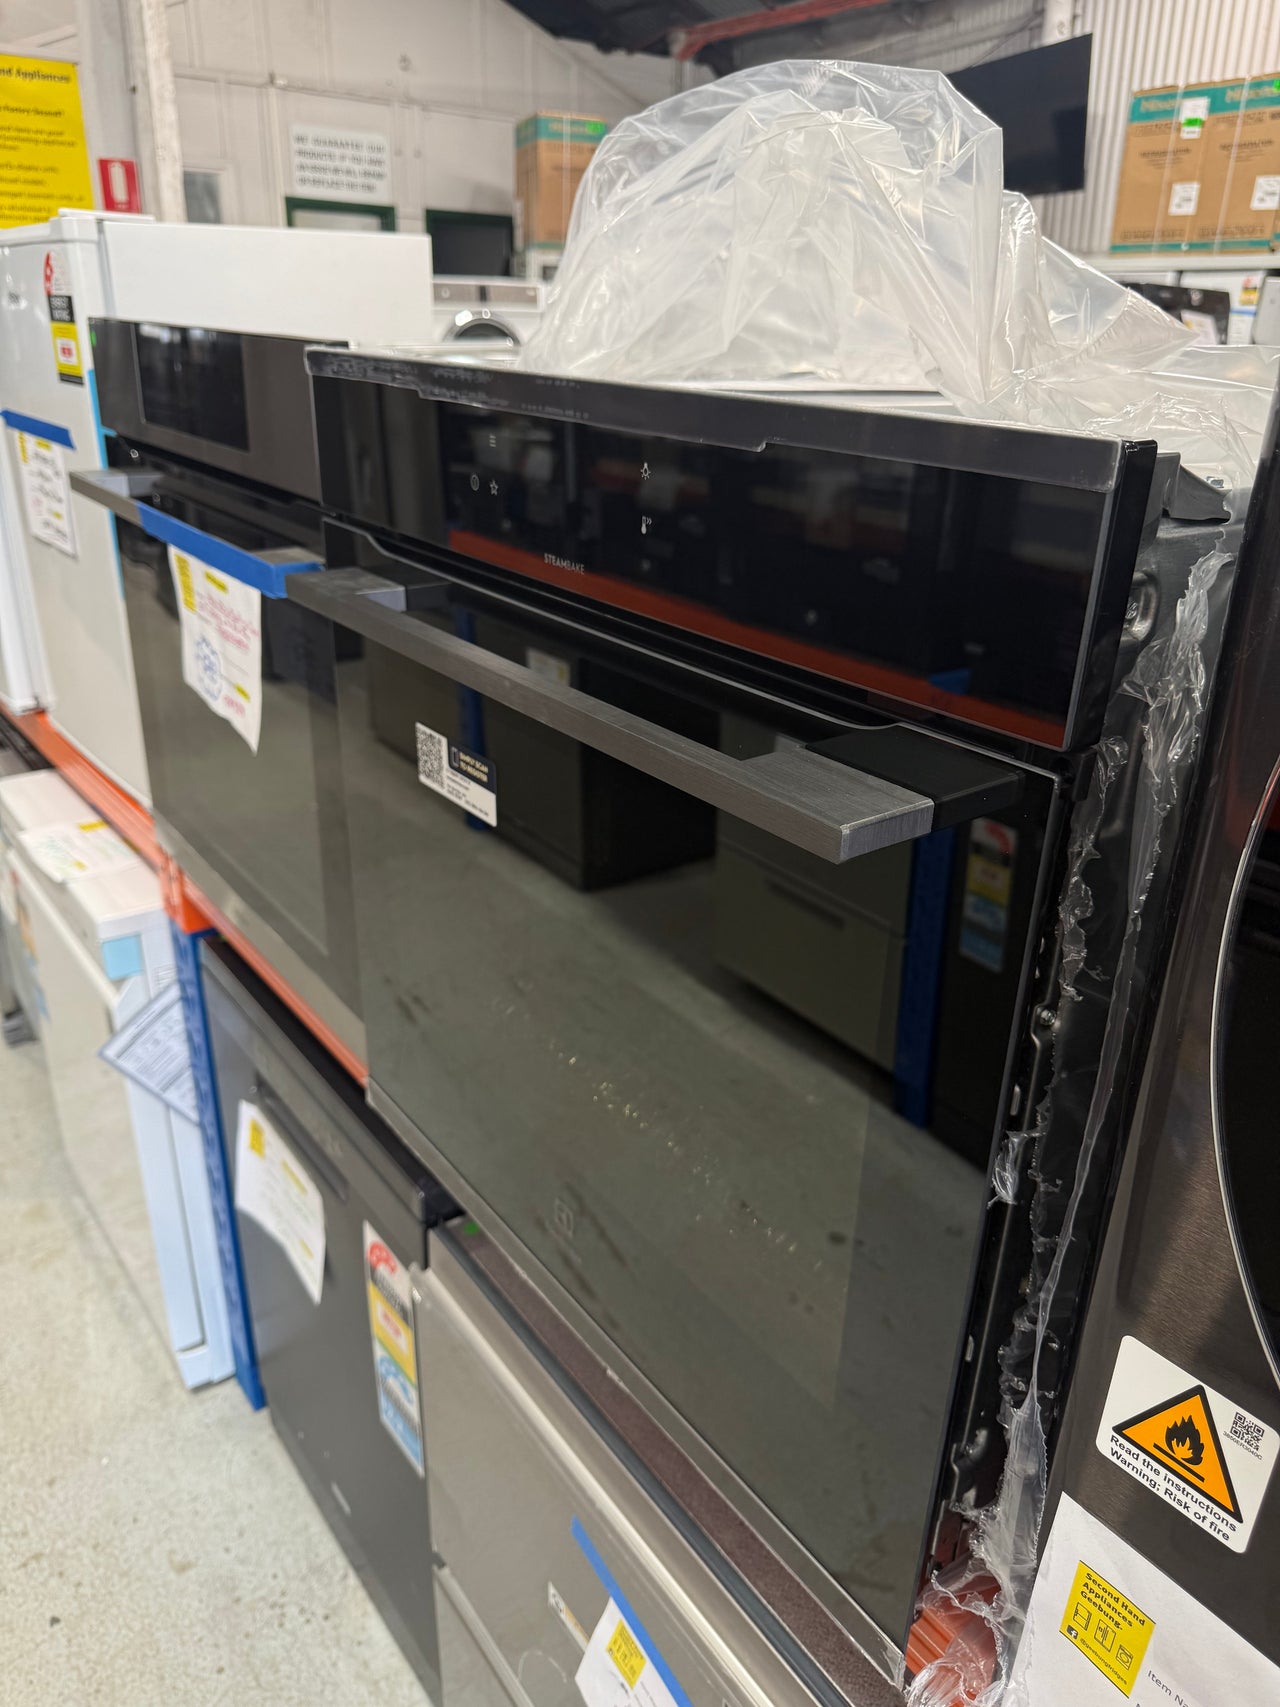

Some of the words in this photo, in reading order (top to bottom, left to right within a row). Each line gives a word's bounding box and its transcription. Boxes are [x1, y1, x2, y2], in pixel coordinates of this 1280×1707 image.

[544, 552, 585, 575] STEAMBAKE
[476, 759, 489, 774] SCAN
[1110, 1434, 1140, 1462] Read
[1142, 1458, 1161, 1477] the
[1163, 1472, 1237, 1532] instructions
[1110, 1446, 1161, 1492] Warning;
[1164, 1487, 1191, 1513] Risk
[1193, 1511, 1208, 1523] of
[1209, 1520, 1230, 1541] fire
[1080, 1590, 1123, 1631] Geebung.
[1082, 1581, 1133, 1627] Appliances
[1085, 1572, 1120, 1604] Second
[1121, 1601, 1146, 1626] Hand
[1080, 1637, 1127, 1686] @geebungfridges
[1148, 1670, 1172, 1696] Item
